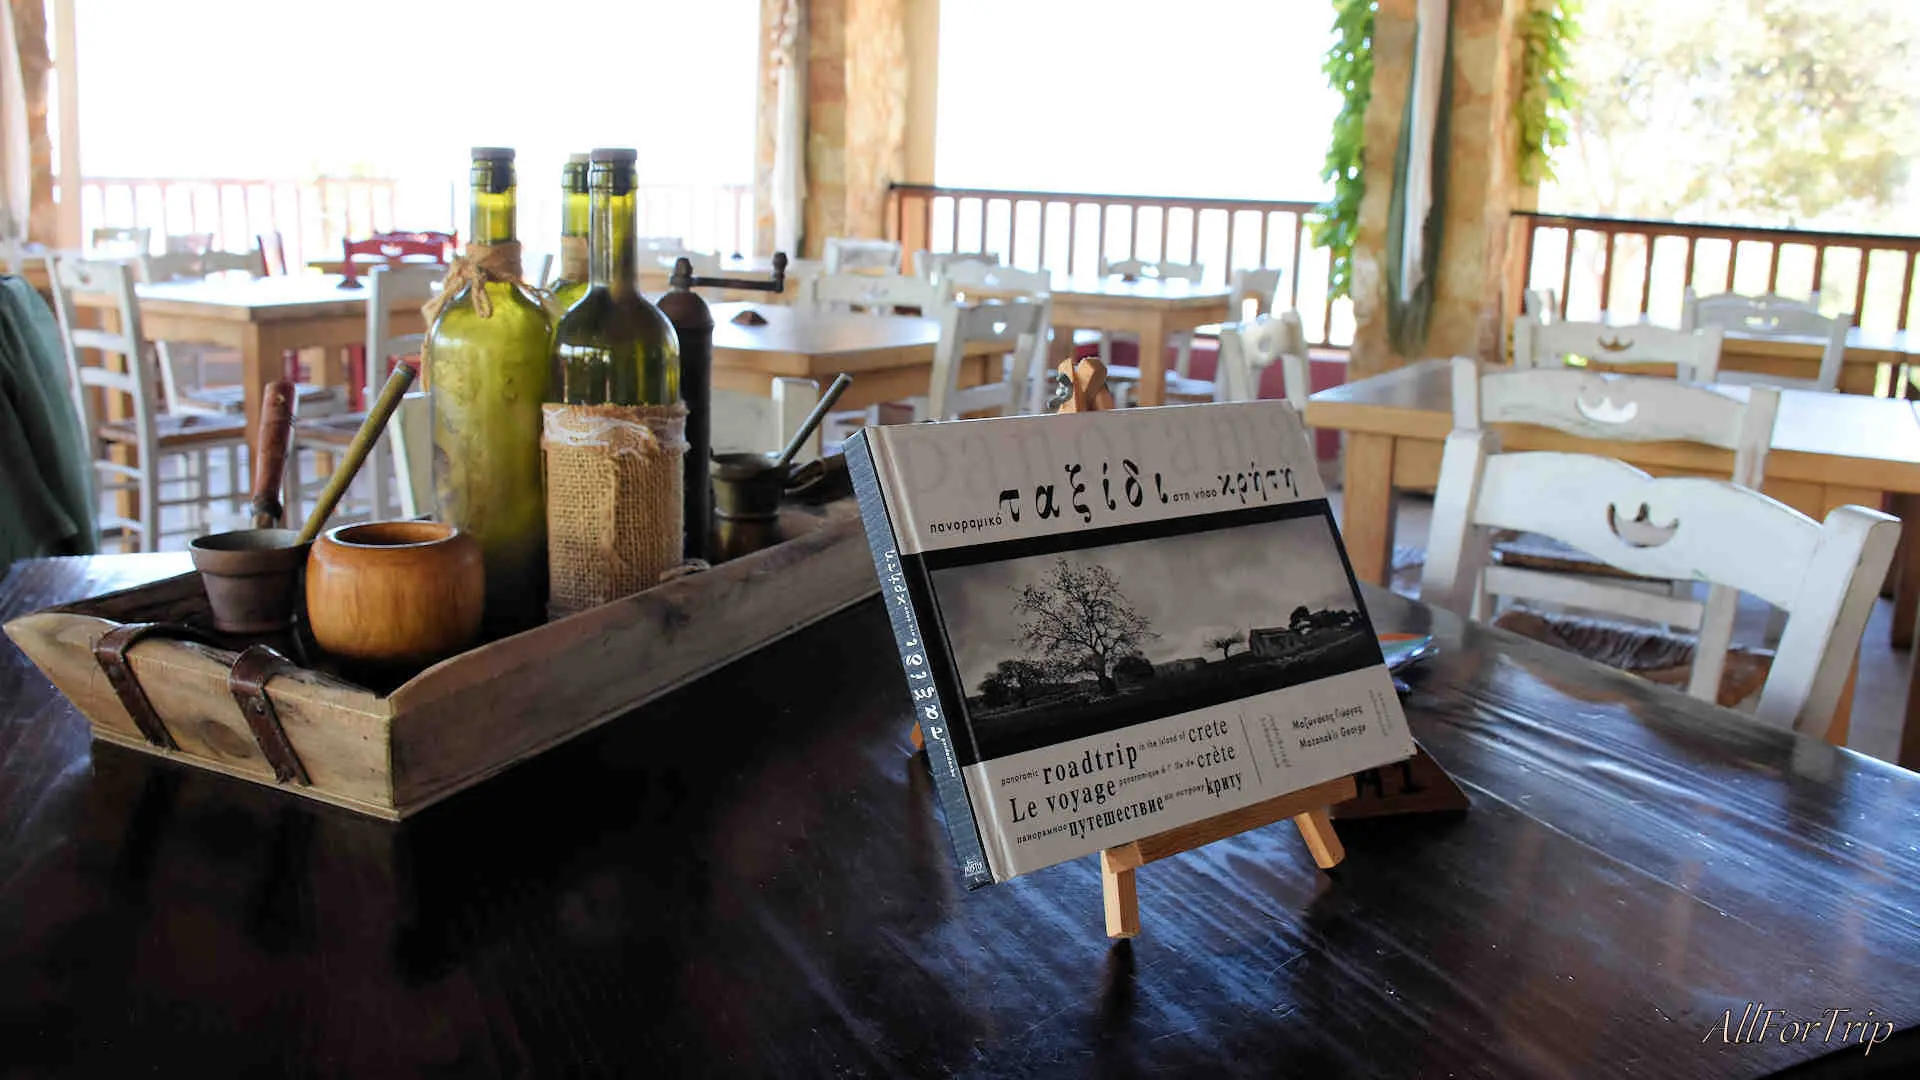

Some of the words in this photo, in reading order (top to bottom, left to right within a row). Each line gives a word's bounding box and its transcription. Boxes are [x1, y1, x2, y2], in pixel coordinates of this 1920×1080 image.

[930, 512, 1002, 533] πανοραμικό
[998, 459, 1168, 522] ταξίδι
[1001, 769, 1039, 787] panoramic
[1043, 742, 1137, 784] roadtrip
[1188, 719, 1228, 743] crete
[1009, 797, 1037, 823] Le
[1046, 779, 1116, 813] voyage
[1197, 744, 1236, 768] crète
[1069, 796, 1164, 839] путешествие
